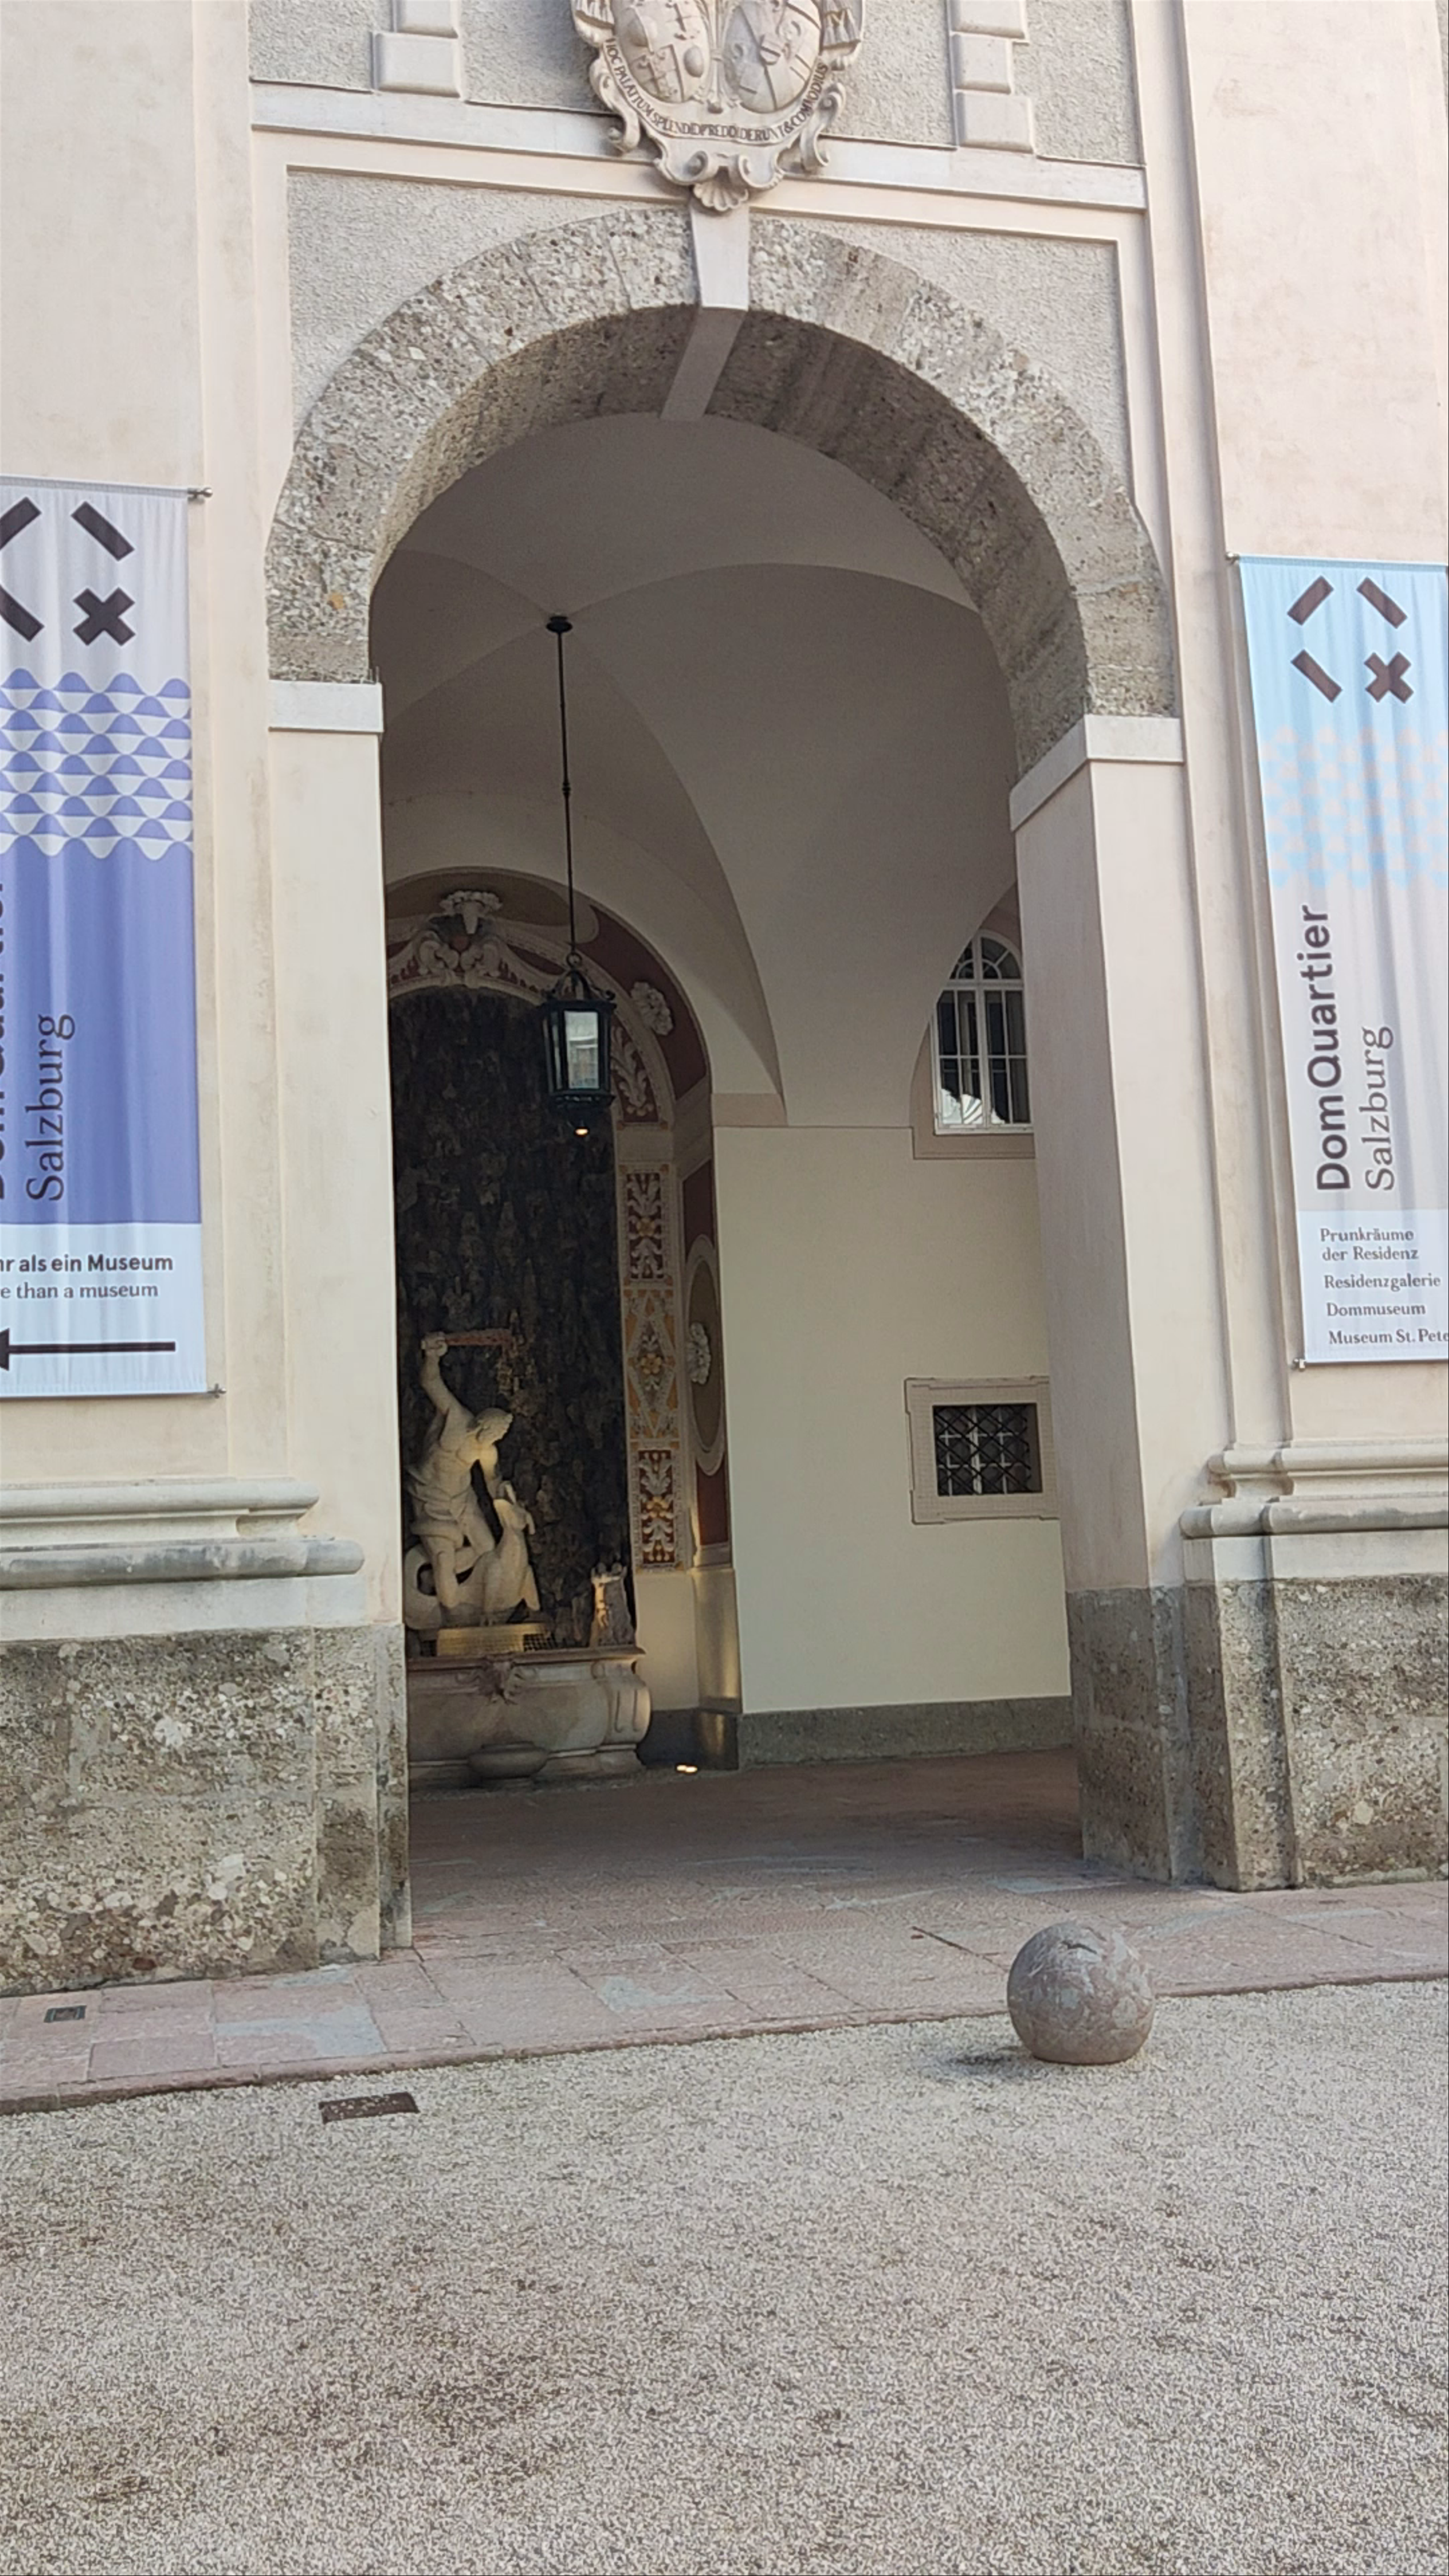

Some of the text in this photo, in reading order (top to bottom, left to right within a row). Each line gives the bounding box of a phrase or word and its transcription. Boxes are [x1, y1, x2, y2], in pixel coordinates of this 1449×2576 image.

[25, 1014, 75, 1200] Salzburg
[1359, 1027, 1394, 1190] Salzburg
[1320, 1227, 1414, 1242] Prunkräume
[1322, 1246, 1418, 1261] der Residenz
[19, 1254, 47, 1272] als
[51, 1254, 82, 1272] ein
[88, 1254, 173, 1272] Museum
[17, 1282, 58, 1299] than
[64, 1287, 74, 1298] a
[80, 1284, 158, 1298] museum
[1324, 1273, 1441, 1292] Residenzgalerie
[1327, 1302, 1426, 1316] Dommuseum
[1329, 1330, 1393, 1344] Museum
[1396, 1329, 1416, 1344] St.
